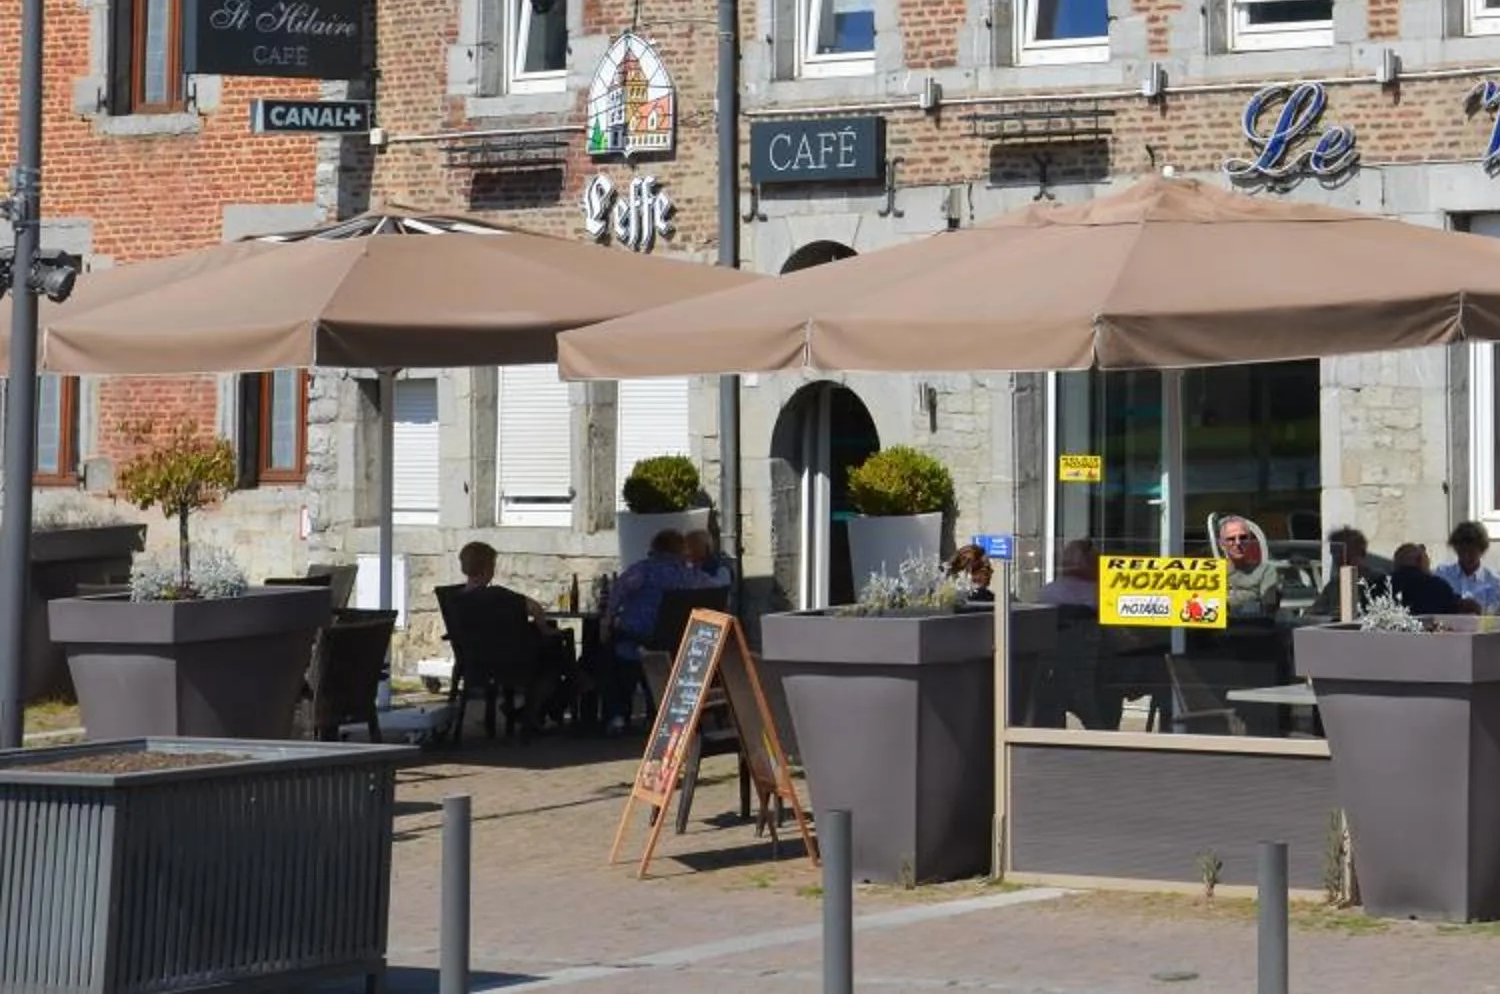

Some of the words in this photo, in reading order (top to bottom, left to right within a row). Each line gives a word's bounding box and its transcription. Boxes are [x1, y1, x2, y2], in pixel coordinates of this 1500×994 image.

[255, 1, 357, 37] Hilaire
[269, 107, 362, 127] CANAL+
[1223, 82, 1362, 178] Le
[769, 125, 857, 171] CAFÉ
[583, 174, 674, 254] Leffe
[1107, 558, 1217, 571] RELAIS
[1110, 571, 1220, 591] MOTARDS
